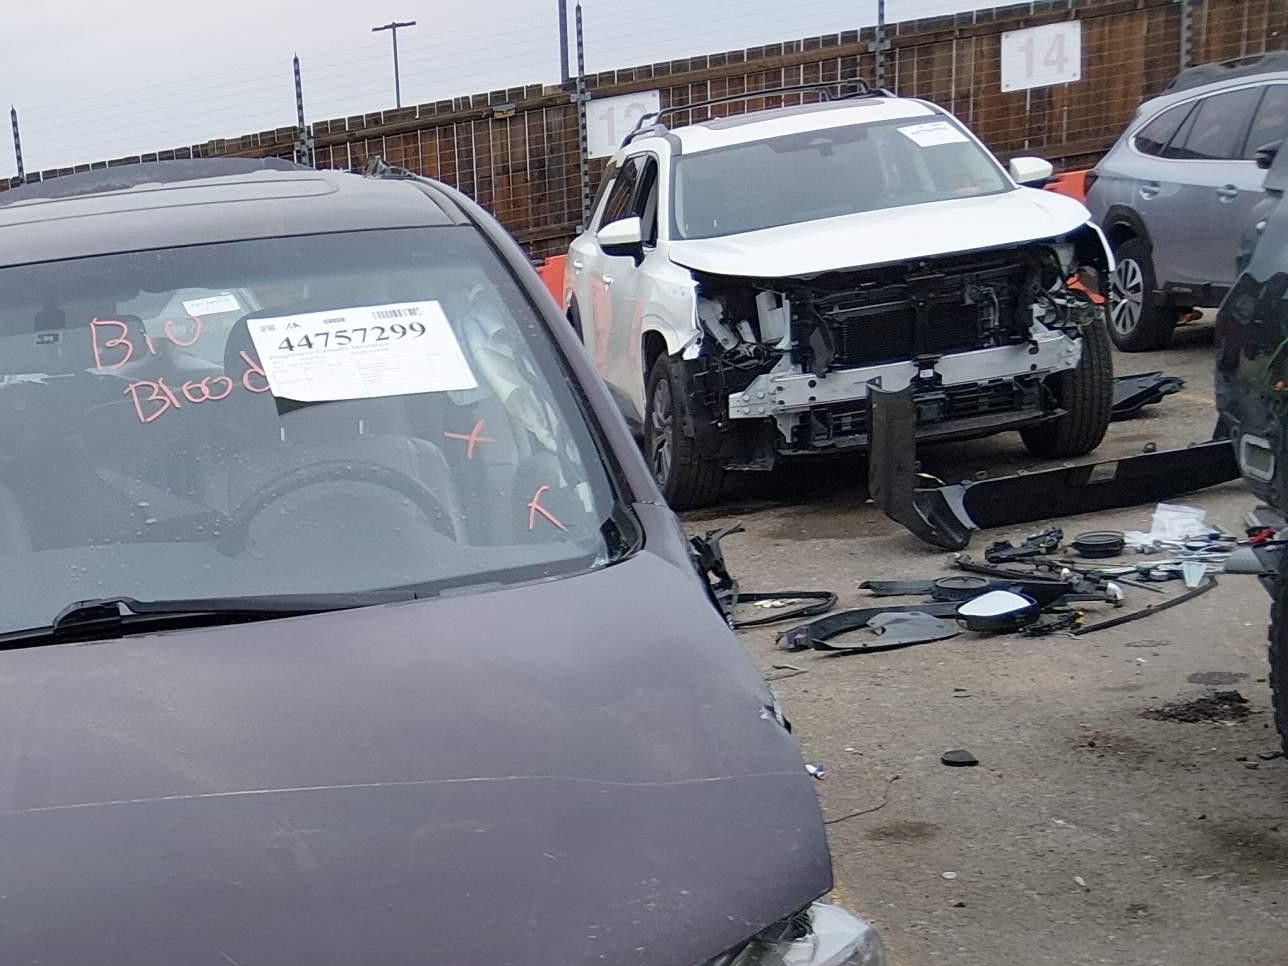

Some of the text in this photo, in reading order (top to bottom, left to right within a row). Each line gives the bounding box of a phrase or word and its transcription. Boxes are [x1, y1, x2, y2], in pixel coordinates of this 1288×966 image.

[1017, 32, 1069, 79] 14
[278, 321, 427, 352] 44757299
[123, 350, 272, 423] Blood
